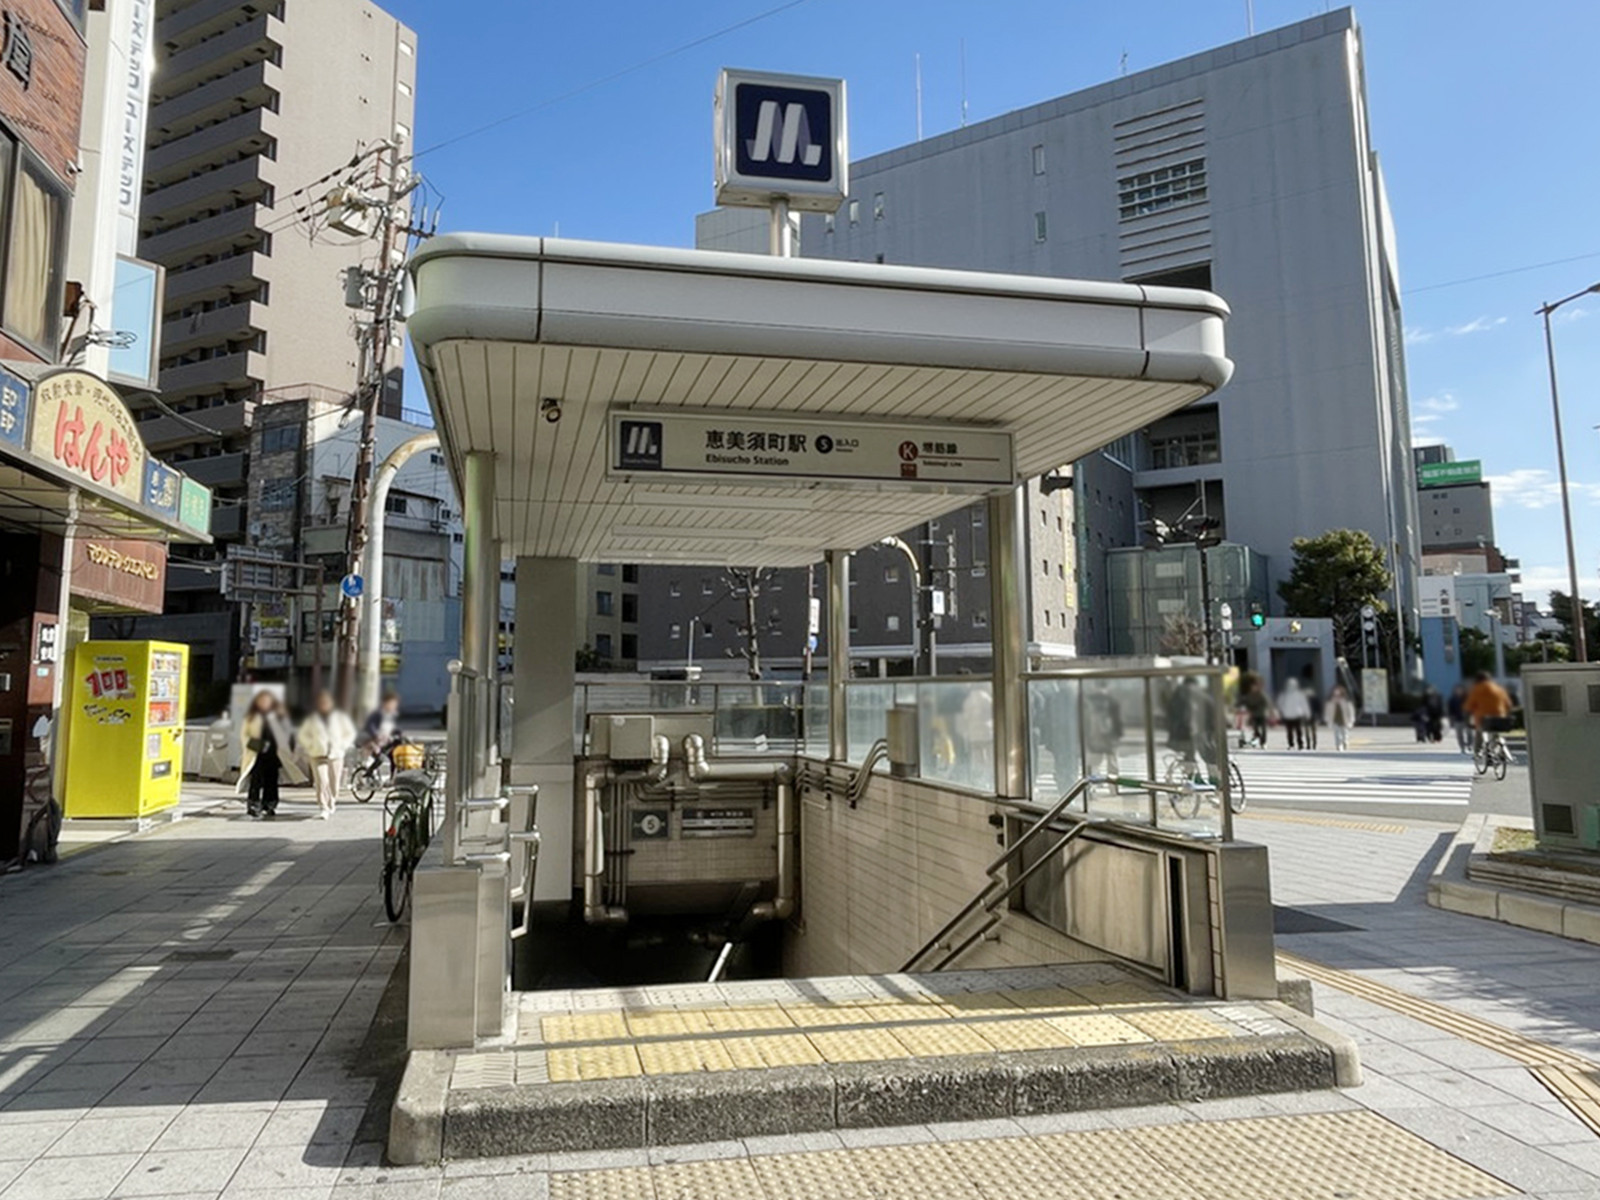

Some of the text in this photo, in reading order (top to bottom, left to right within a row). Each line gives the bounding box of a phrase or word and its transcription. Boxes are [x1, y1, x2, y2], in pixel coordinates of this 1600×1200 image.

[55, 400, 131, 487] はんや
[705, 430, 807, 453] 恵美須町駅
[706, 453, 789, 466] Ebisucho Station
[86, 669, 128, 698] 100
